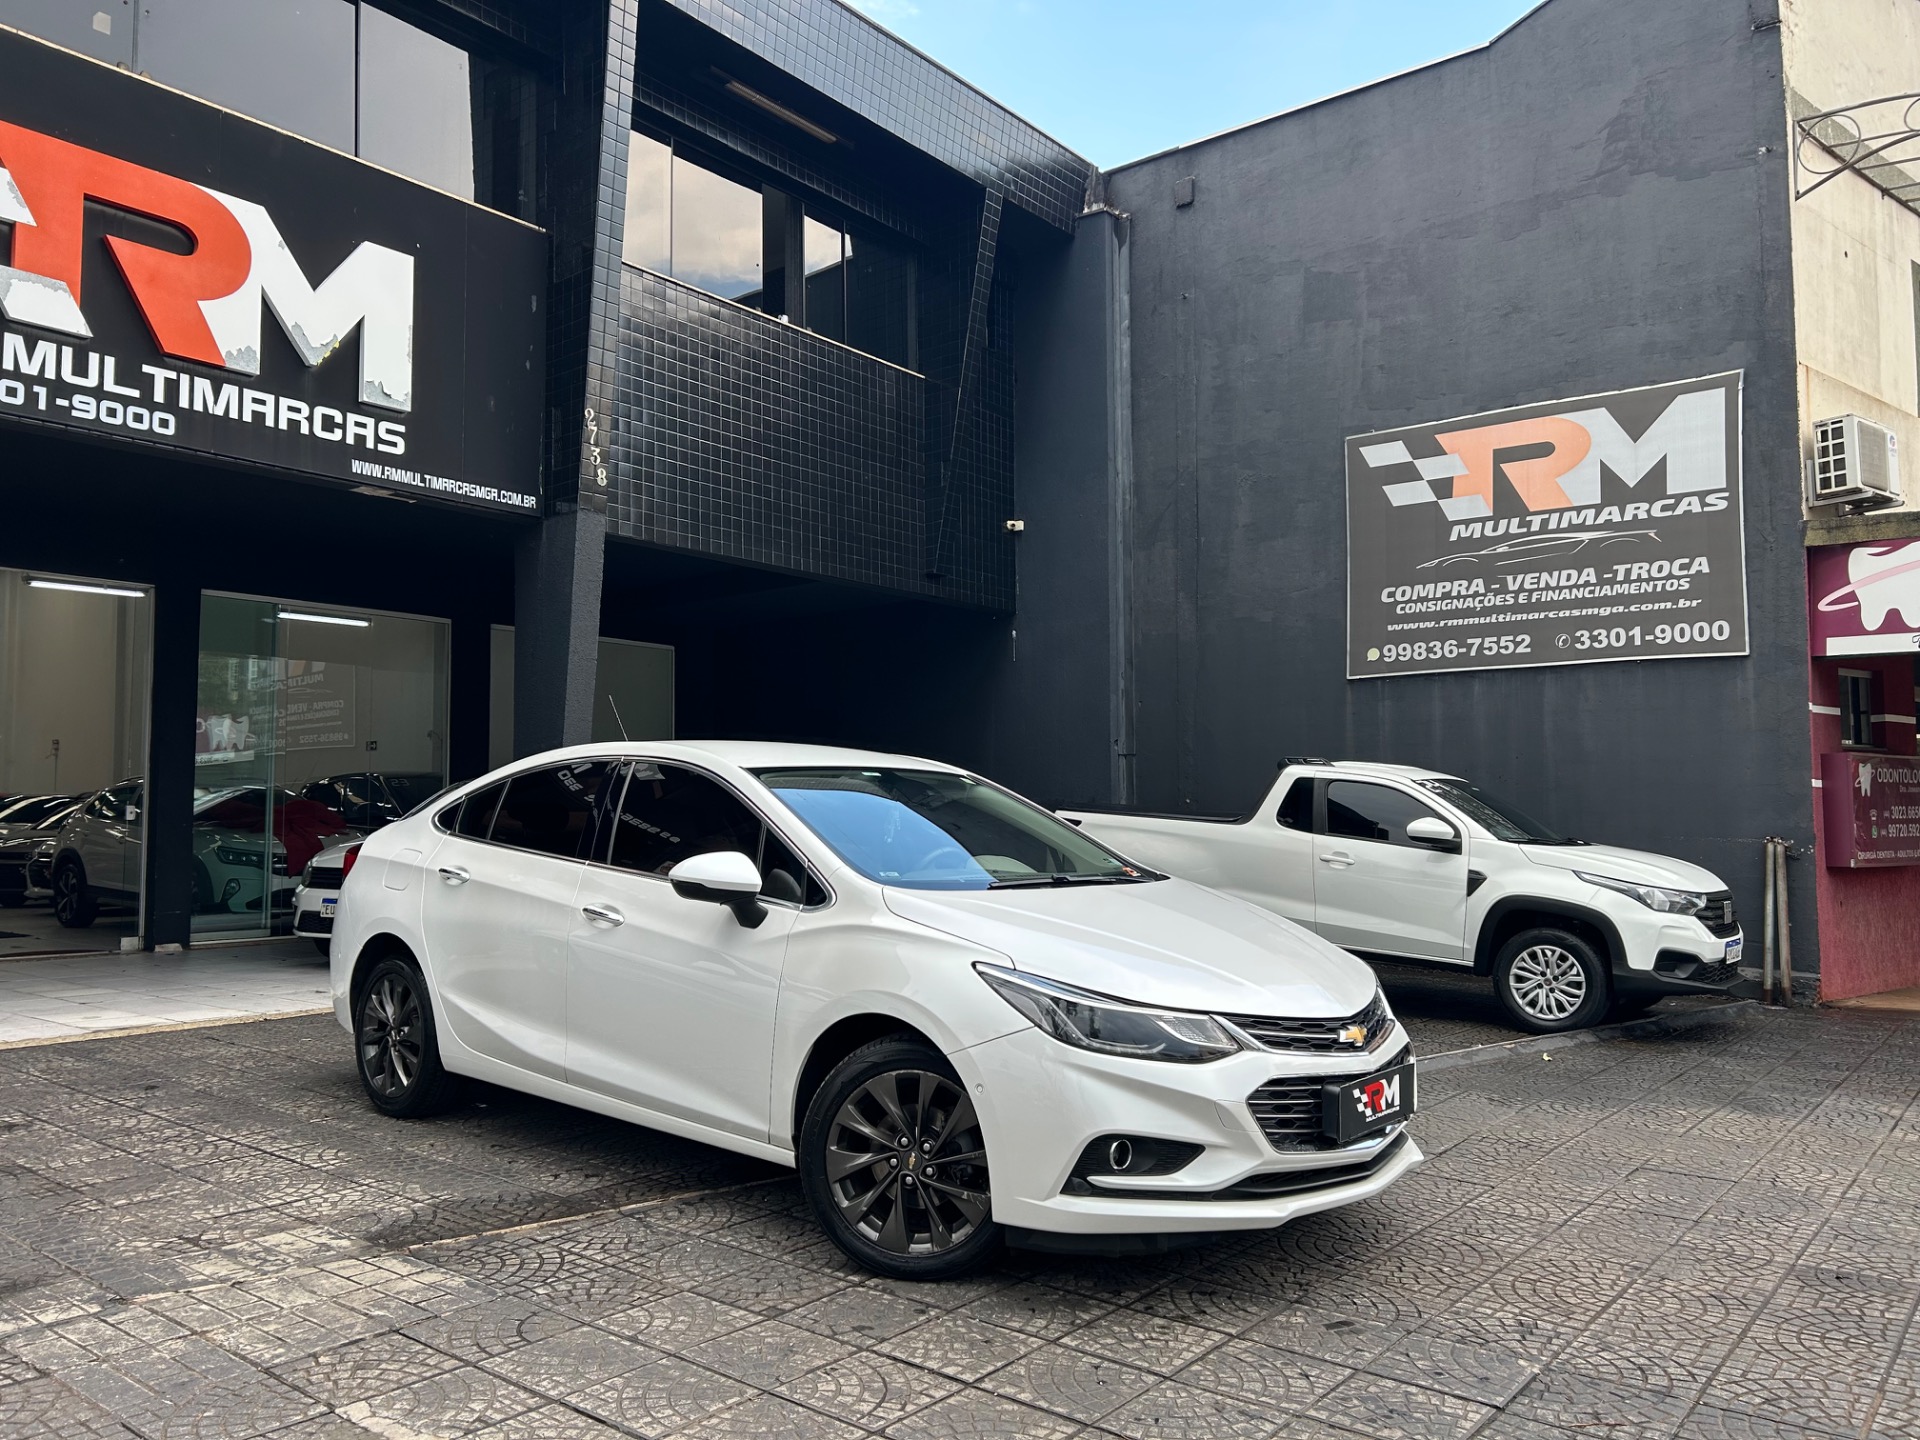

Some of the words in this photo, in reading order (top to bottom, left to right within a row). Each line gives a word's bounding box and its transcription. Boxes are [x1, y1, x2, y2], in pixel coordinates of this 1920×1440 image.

[0, 118, 415, 412] RM
[0, 378, 176, 436] 01-9000
[3, 332, 406, 455] MULTIMARCAS
[584, 408, 607, 487] 2738
[1434, 387, 1727, 512] RM
[351, 459, 537, 509] WWW.RMMULTIMARCASMGA.COM.BR
[1449, 491, 1730, 541] MULTIMARCAS
[1381, 578, 1485, 603] COMPRA
[1506, 567, 1597, 591] VENDA
[1396, 593, 1515, 614] CONSIGNAÇÕES
[1518, 592, 1528, 604] E
[1531, 577, 1691, 603] FINANCIAMENTOS
[1387, 598, 1703, 631] www.rmmultimarcasmga.com.br
[1383, 634, 1532, 662] 99836-7552
[1574, 620, 1731, 650] 3301-9000
[1877, 768, 1920, 784] ODONTOLO
[1364, 1074, 1400, 1112] RM
